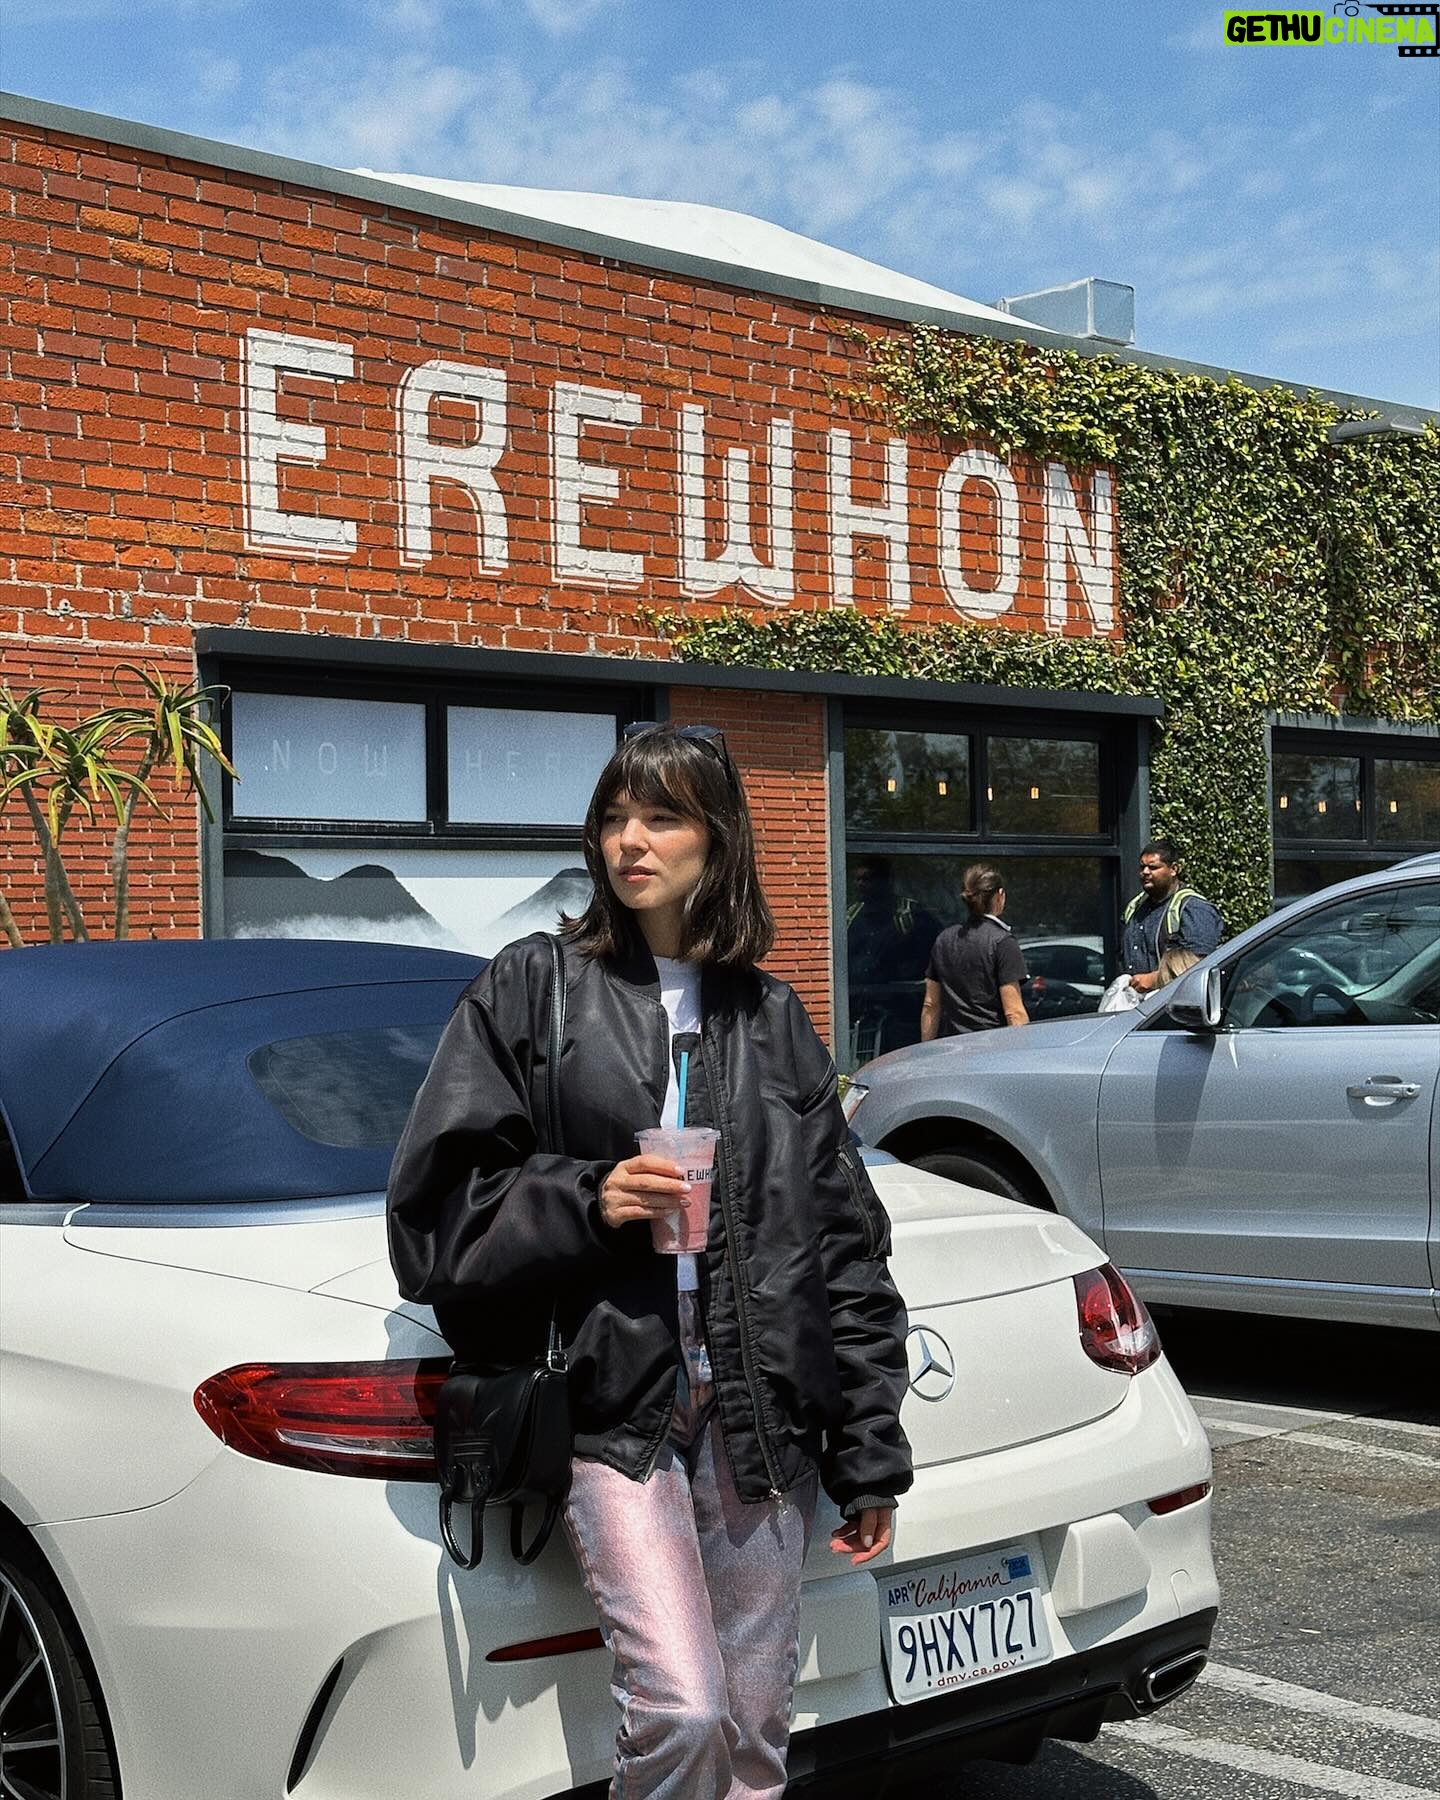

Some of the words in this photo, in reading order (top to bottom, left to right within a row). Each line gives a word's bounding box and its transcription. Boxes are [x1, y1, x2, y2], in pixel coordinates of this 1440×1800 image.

[241, 327, 1119, 636] EREWHON
[271, 738, 388, 778] NOW
[888, 1586, 910, 1606] APR
[914, 1571, 1011, 1608] California
[898, 1591, 1037, 1684] 9HXY727
[937, 1657, 1018, 1688] dmv.ca.gov
